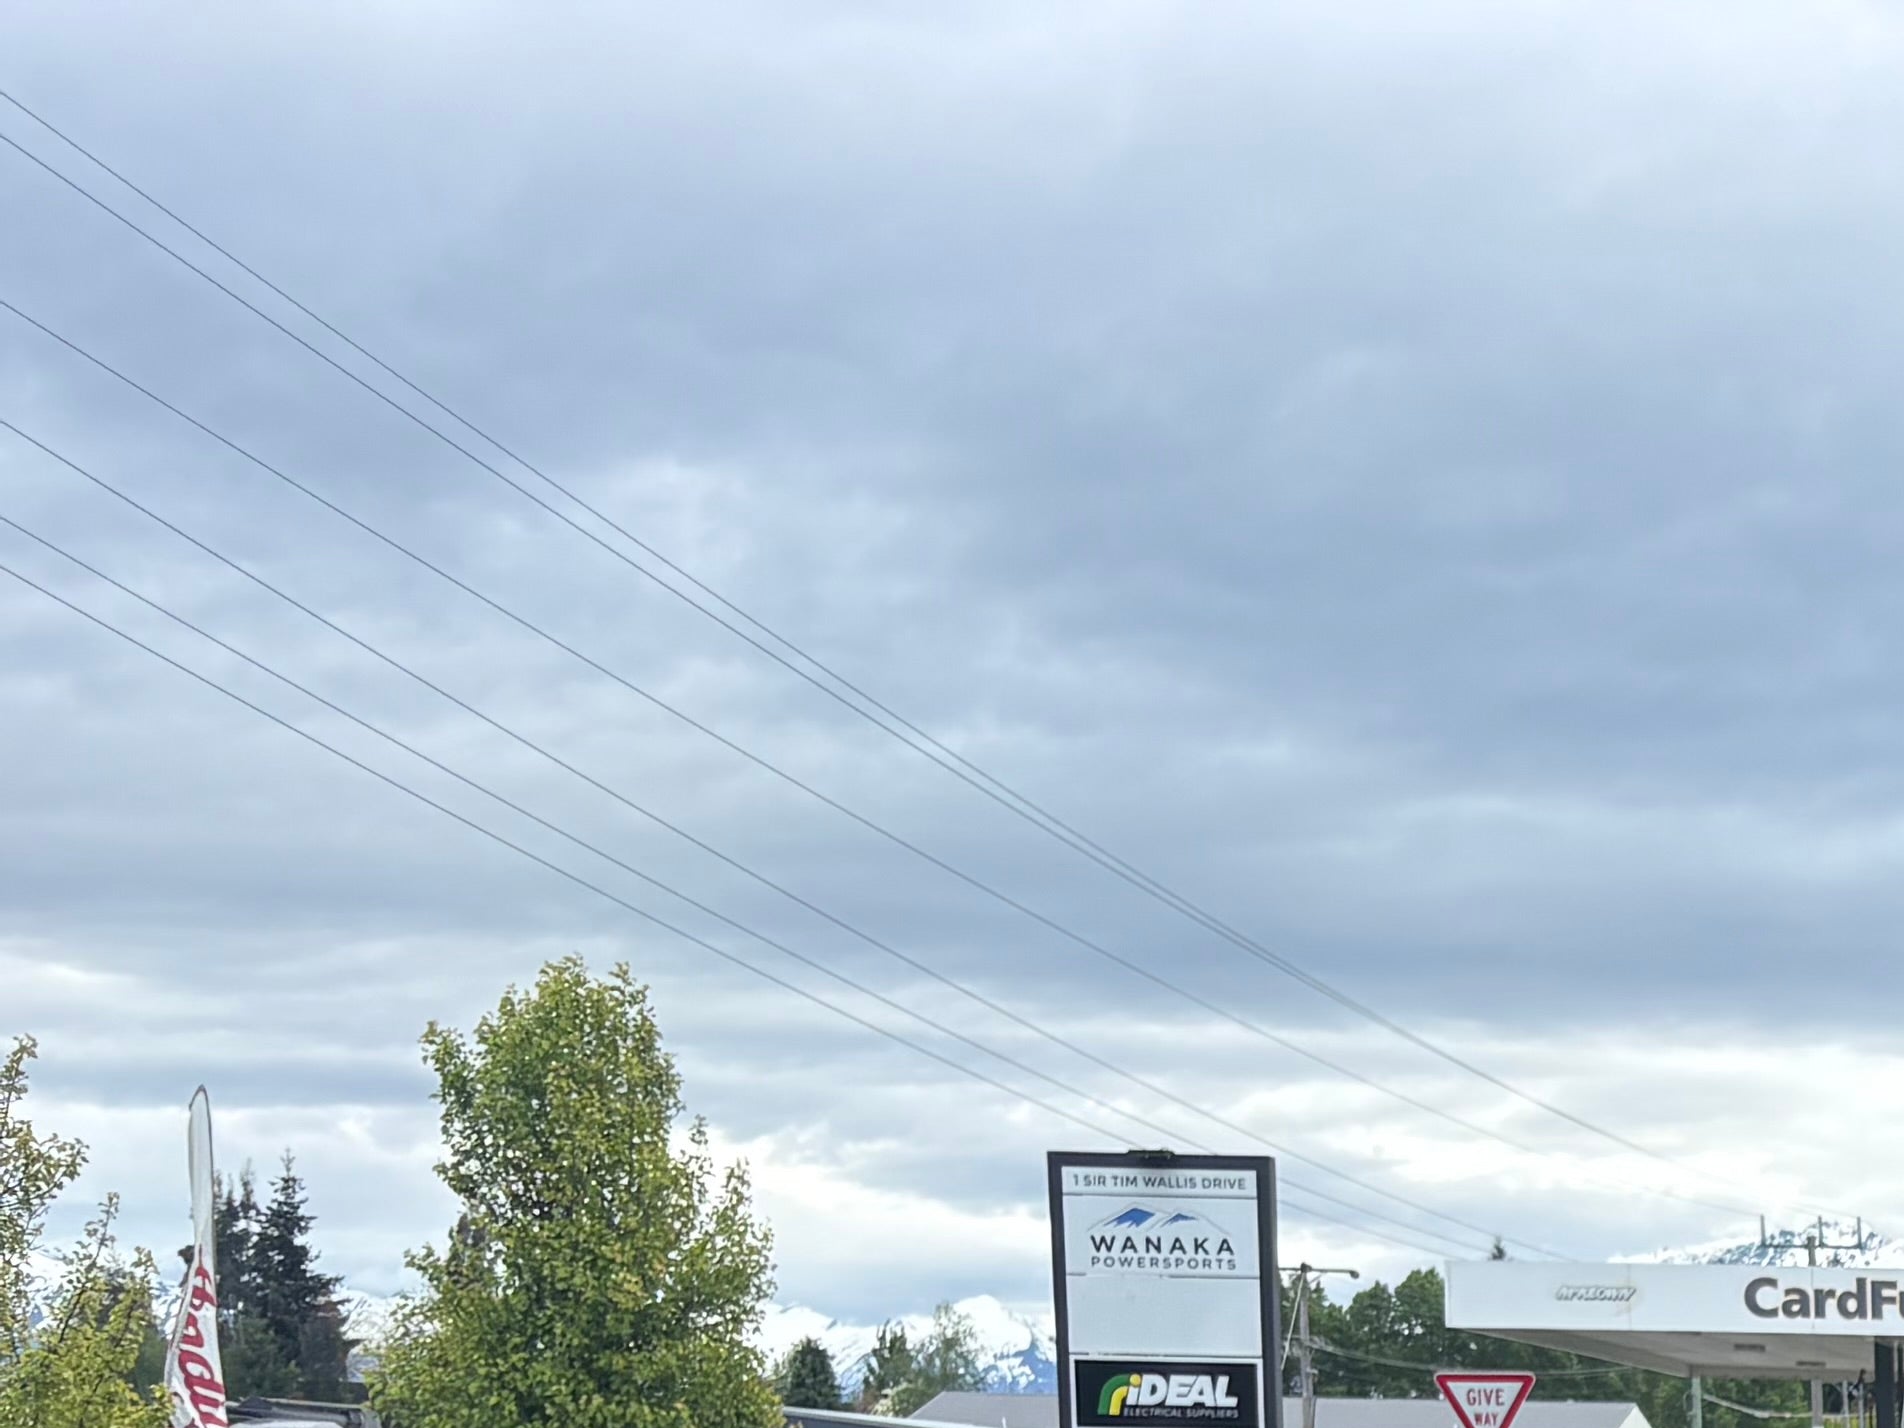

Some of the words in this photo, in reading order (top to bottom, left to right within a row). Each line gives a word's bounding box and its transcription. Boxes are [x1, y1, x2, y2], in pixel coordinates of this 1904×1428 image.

[1072, 1174, 1079, 1186] 1
[1083, 1174, 1106, 1187] SIR
[1111, 1175, 1138, 1188] TIM
[1143, 1176, 1197, 1189] WALLIS
[1202, 1178, 1247, 1190] DRIVE
[1090, 1235, 1235, 1255] WANAKA
[1091, 1255, 1237, 1270] POWERSPORTS
[1466, 1388, 1505, 1406] GIVE
[1123, 1407, 1182, 1417] ELECTRICAL
[1187, 1408, 1239, 1418] SUPPLIERS
[1474, 1412, 1499, 1426] WAY
